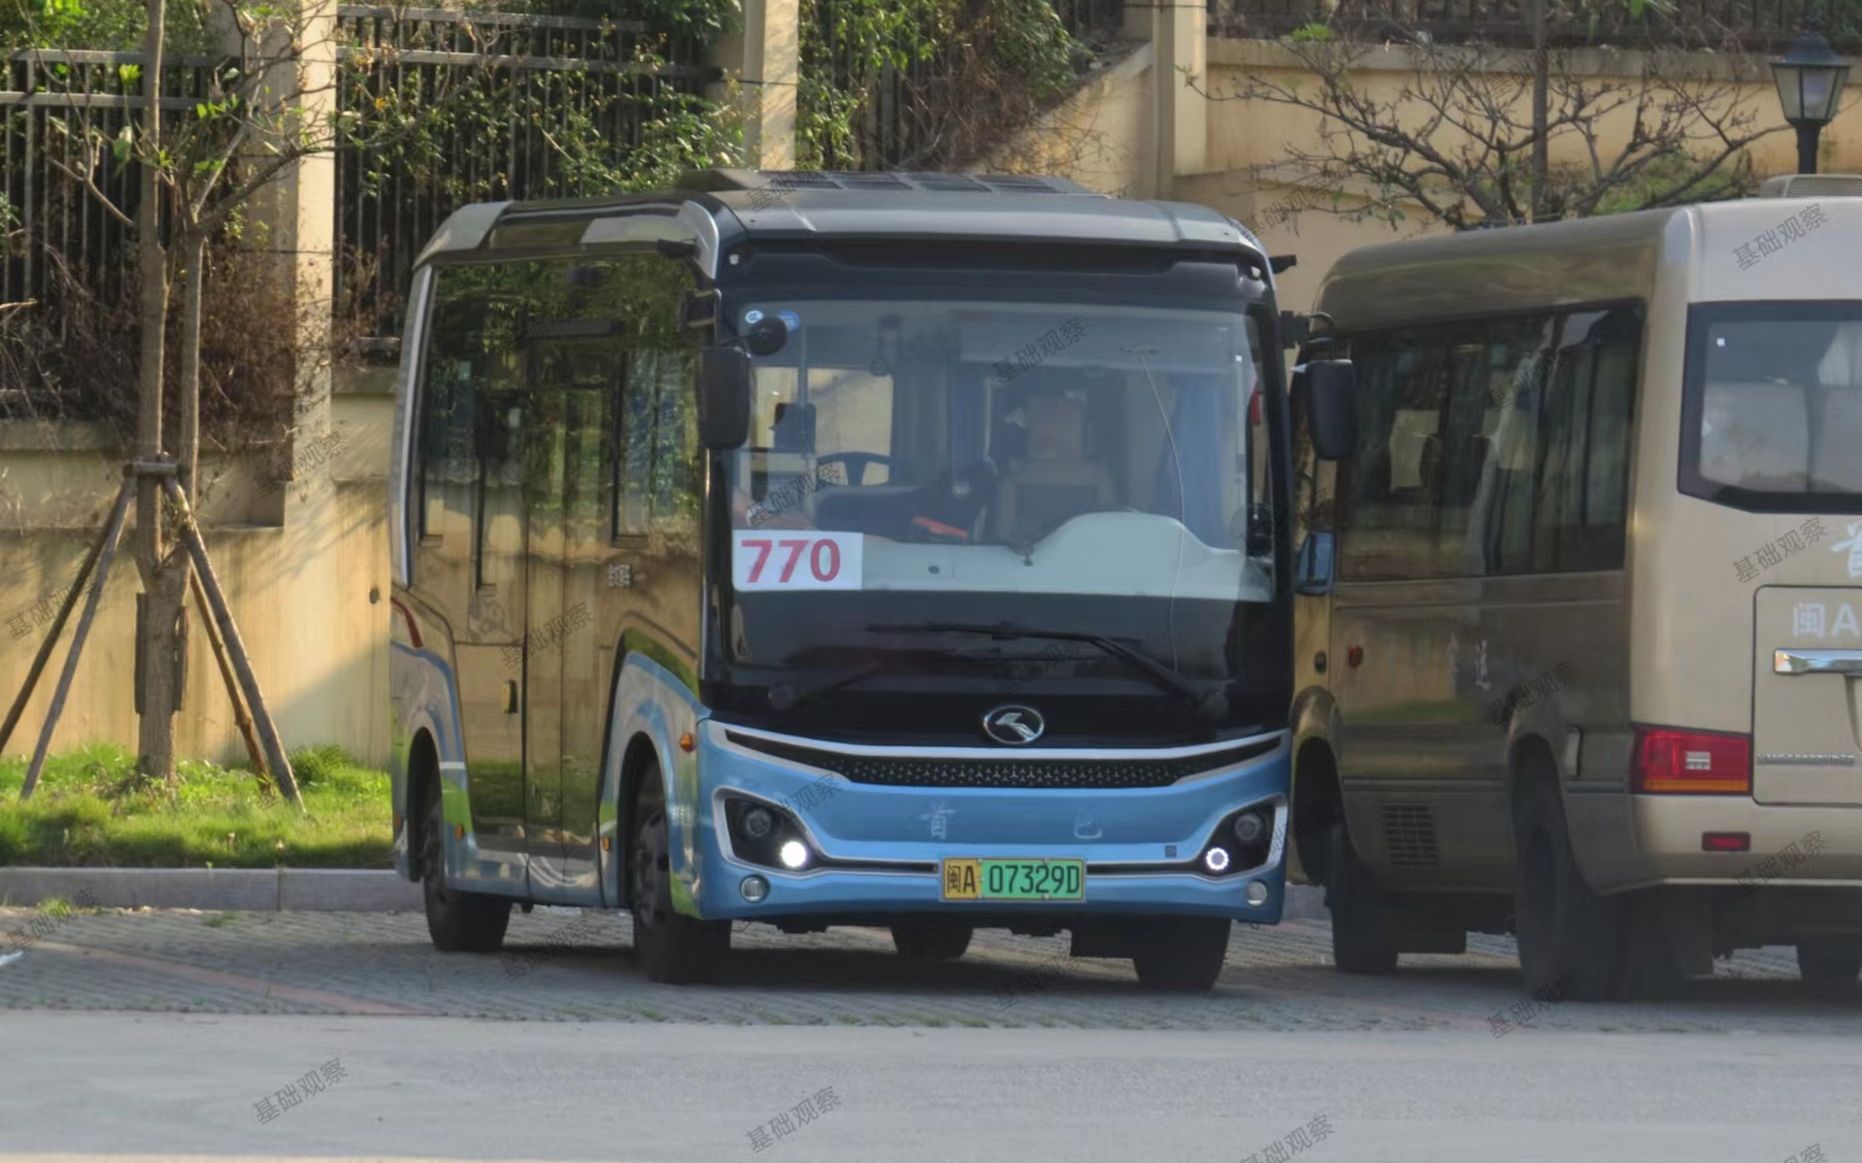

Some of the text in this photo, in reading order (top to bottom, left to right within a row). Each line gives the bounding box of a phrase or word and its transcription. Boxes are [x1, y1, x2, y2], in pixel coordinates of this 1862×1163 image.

[741, 539, 841, 583] 770
[1792, 600, 1862, 639] 闽A
[947, 864, 1080, 894] 闽A 07329D
